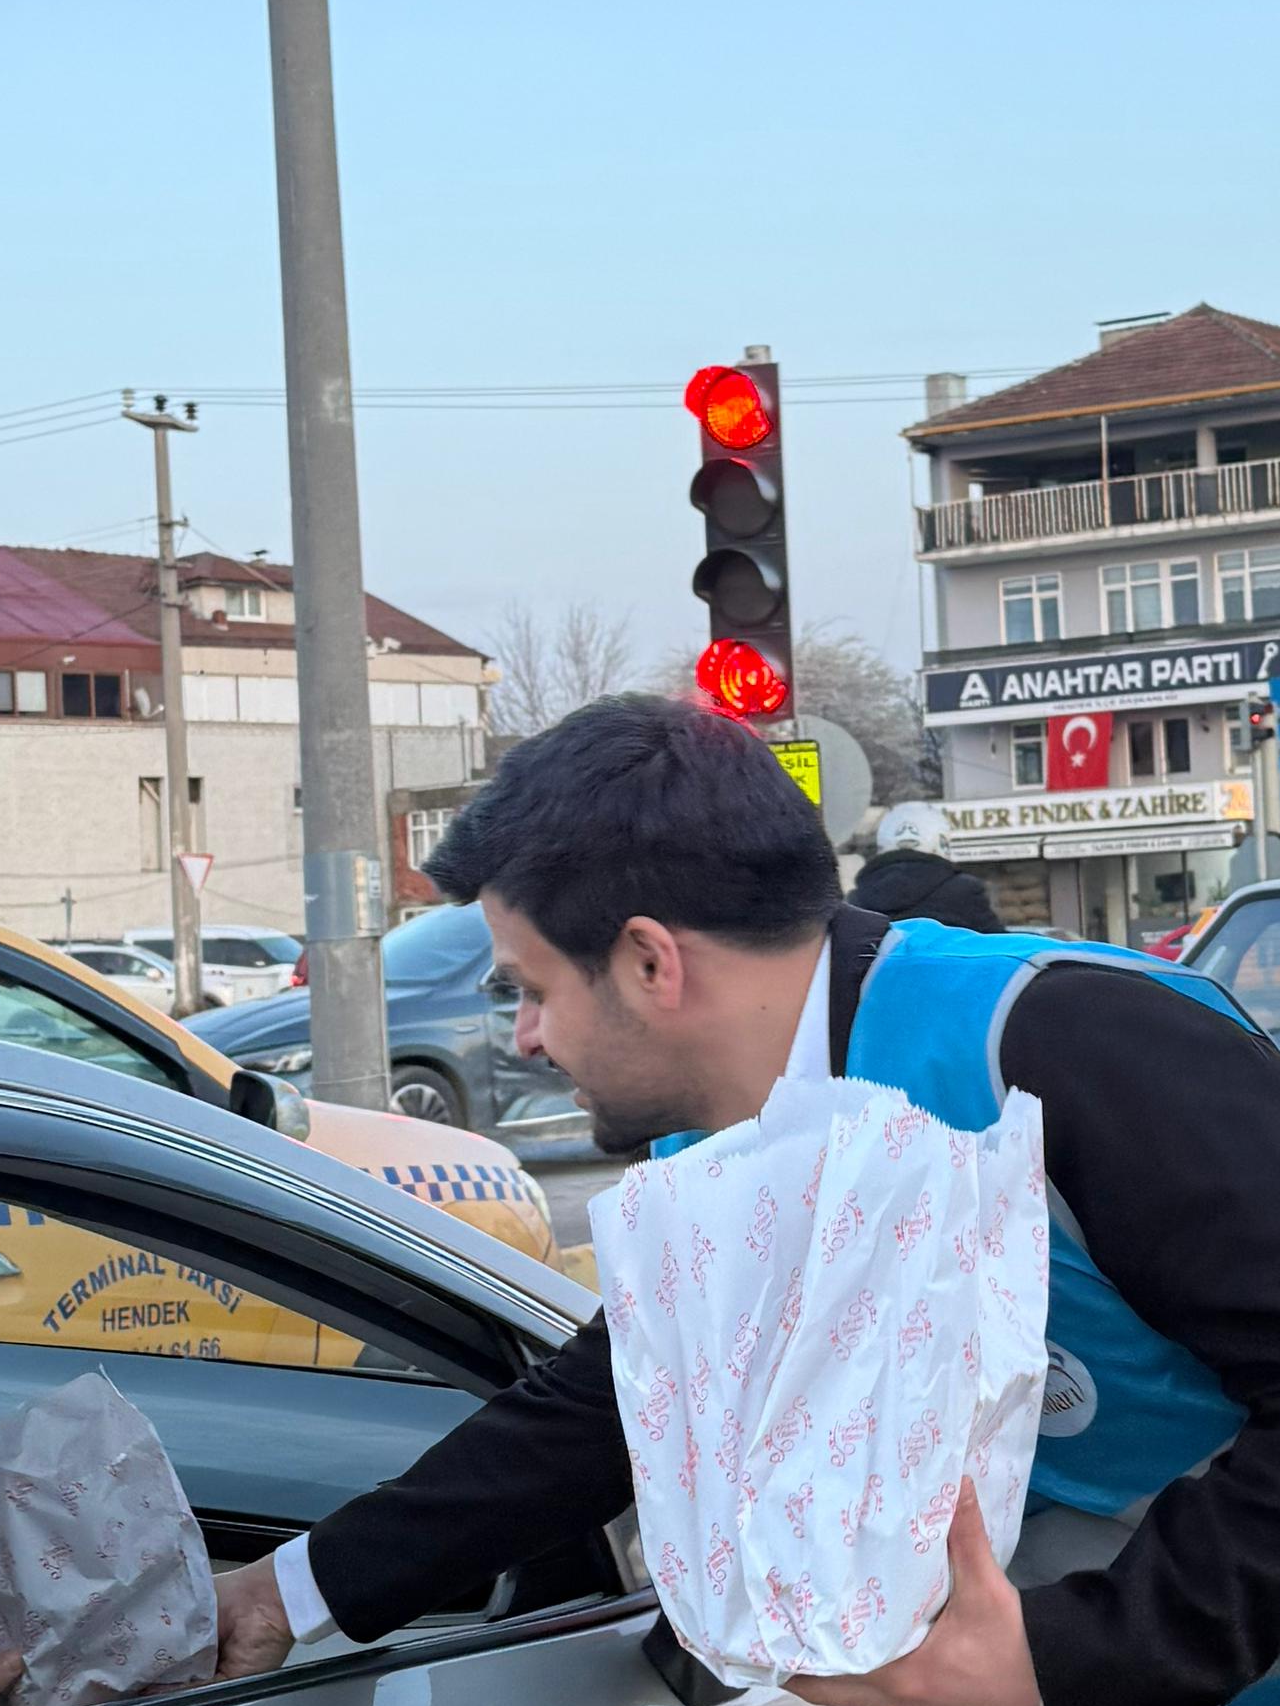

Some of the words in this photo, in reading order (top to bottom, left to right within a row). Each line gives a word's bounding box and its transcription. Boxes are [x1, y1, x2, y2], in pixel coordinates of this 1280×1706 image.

[1002, 661, 1144, 701] ANAHTAR
[1019, 799, 1092, 825] FINDIK
[1098, 801, 1112, 820] &
[1118, 788, 1207, 819] ZAHİRE
[43, 1252, 167, 1334] TERMİNAL
[102, 1300, 191, 1333] HENDEK
